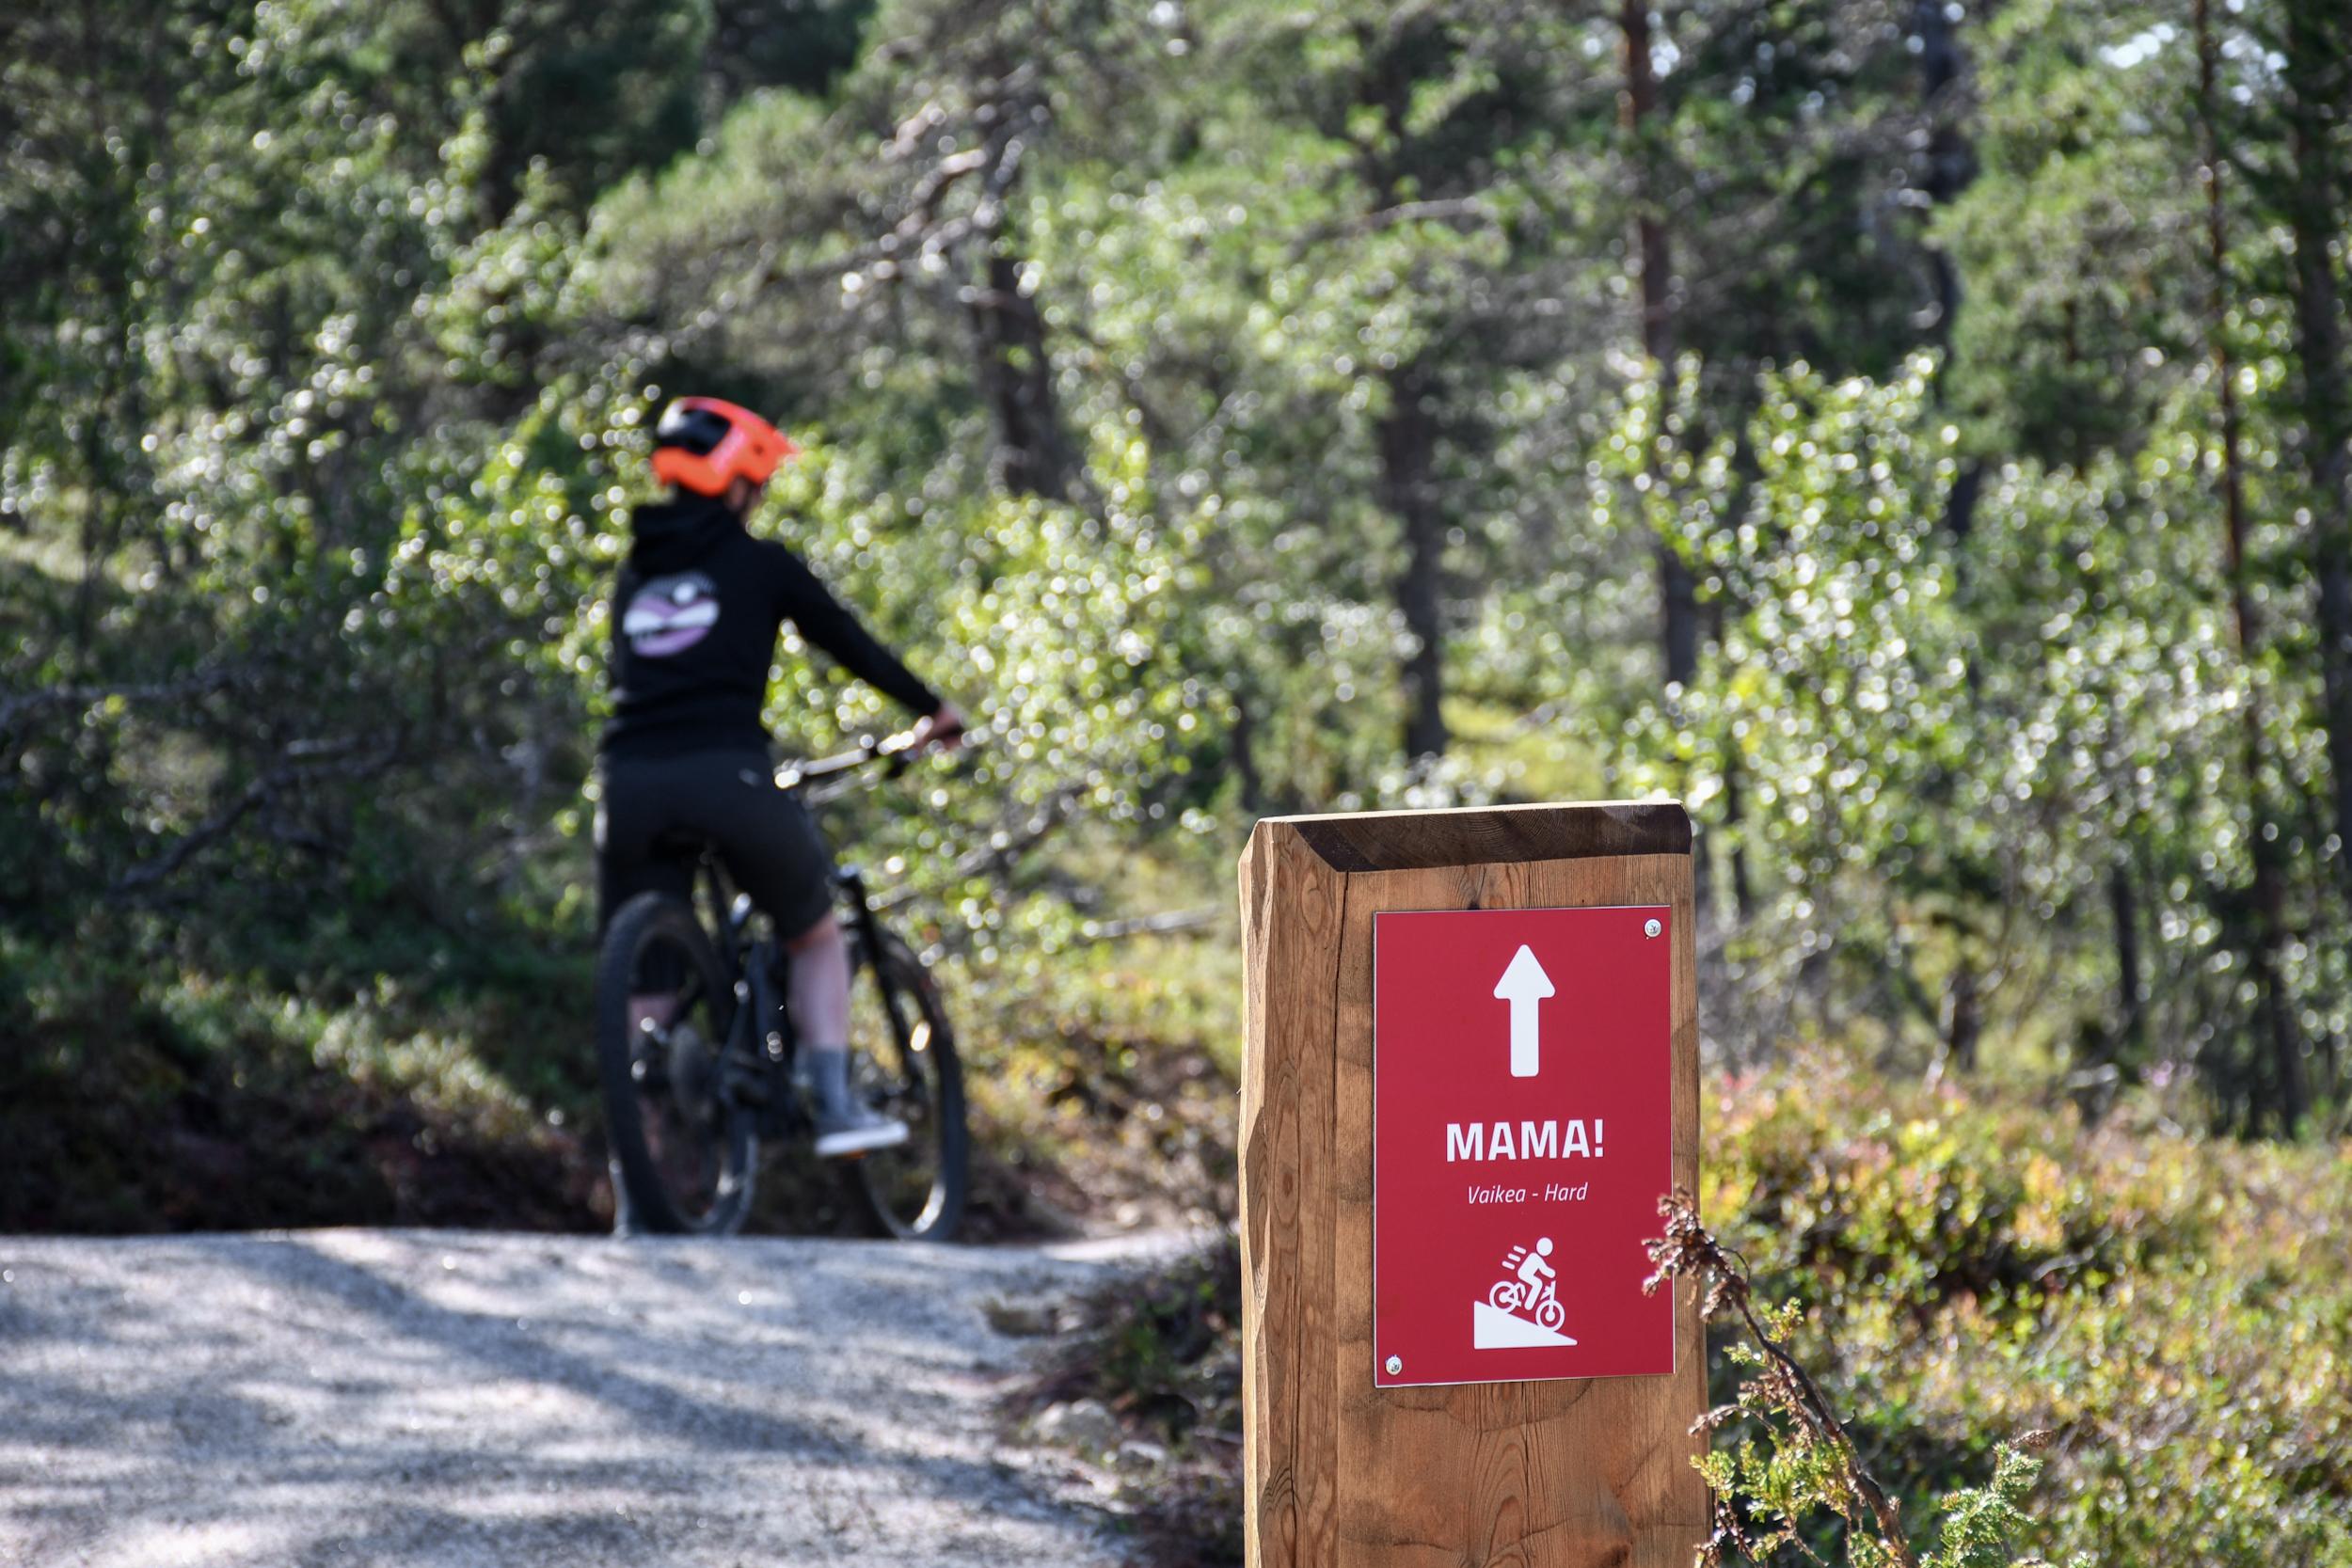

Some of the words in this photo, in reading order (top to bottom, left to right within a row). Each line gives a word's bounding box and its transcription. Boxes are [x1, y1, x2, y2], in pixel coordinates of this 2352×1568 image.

[1446, 1118, 1604, 1163] MAMA!
[1468, 1184, 1527, 1204] Vaikea
[1544, 1181, 1589, 1202] Hard
